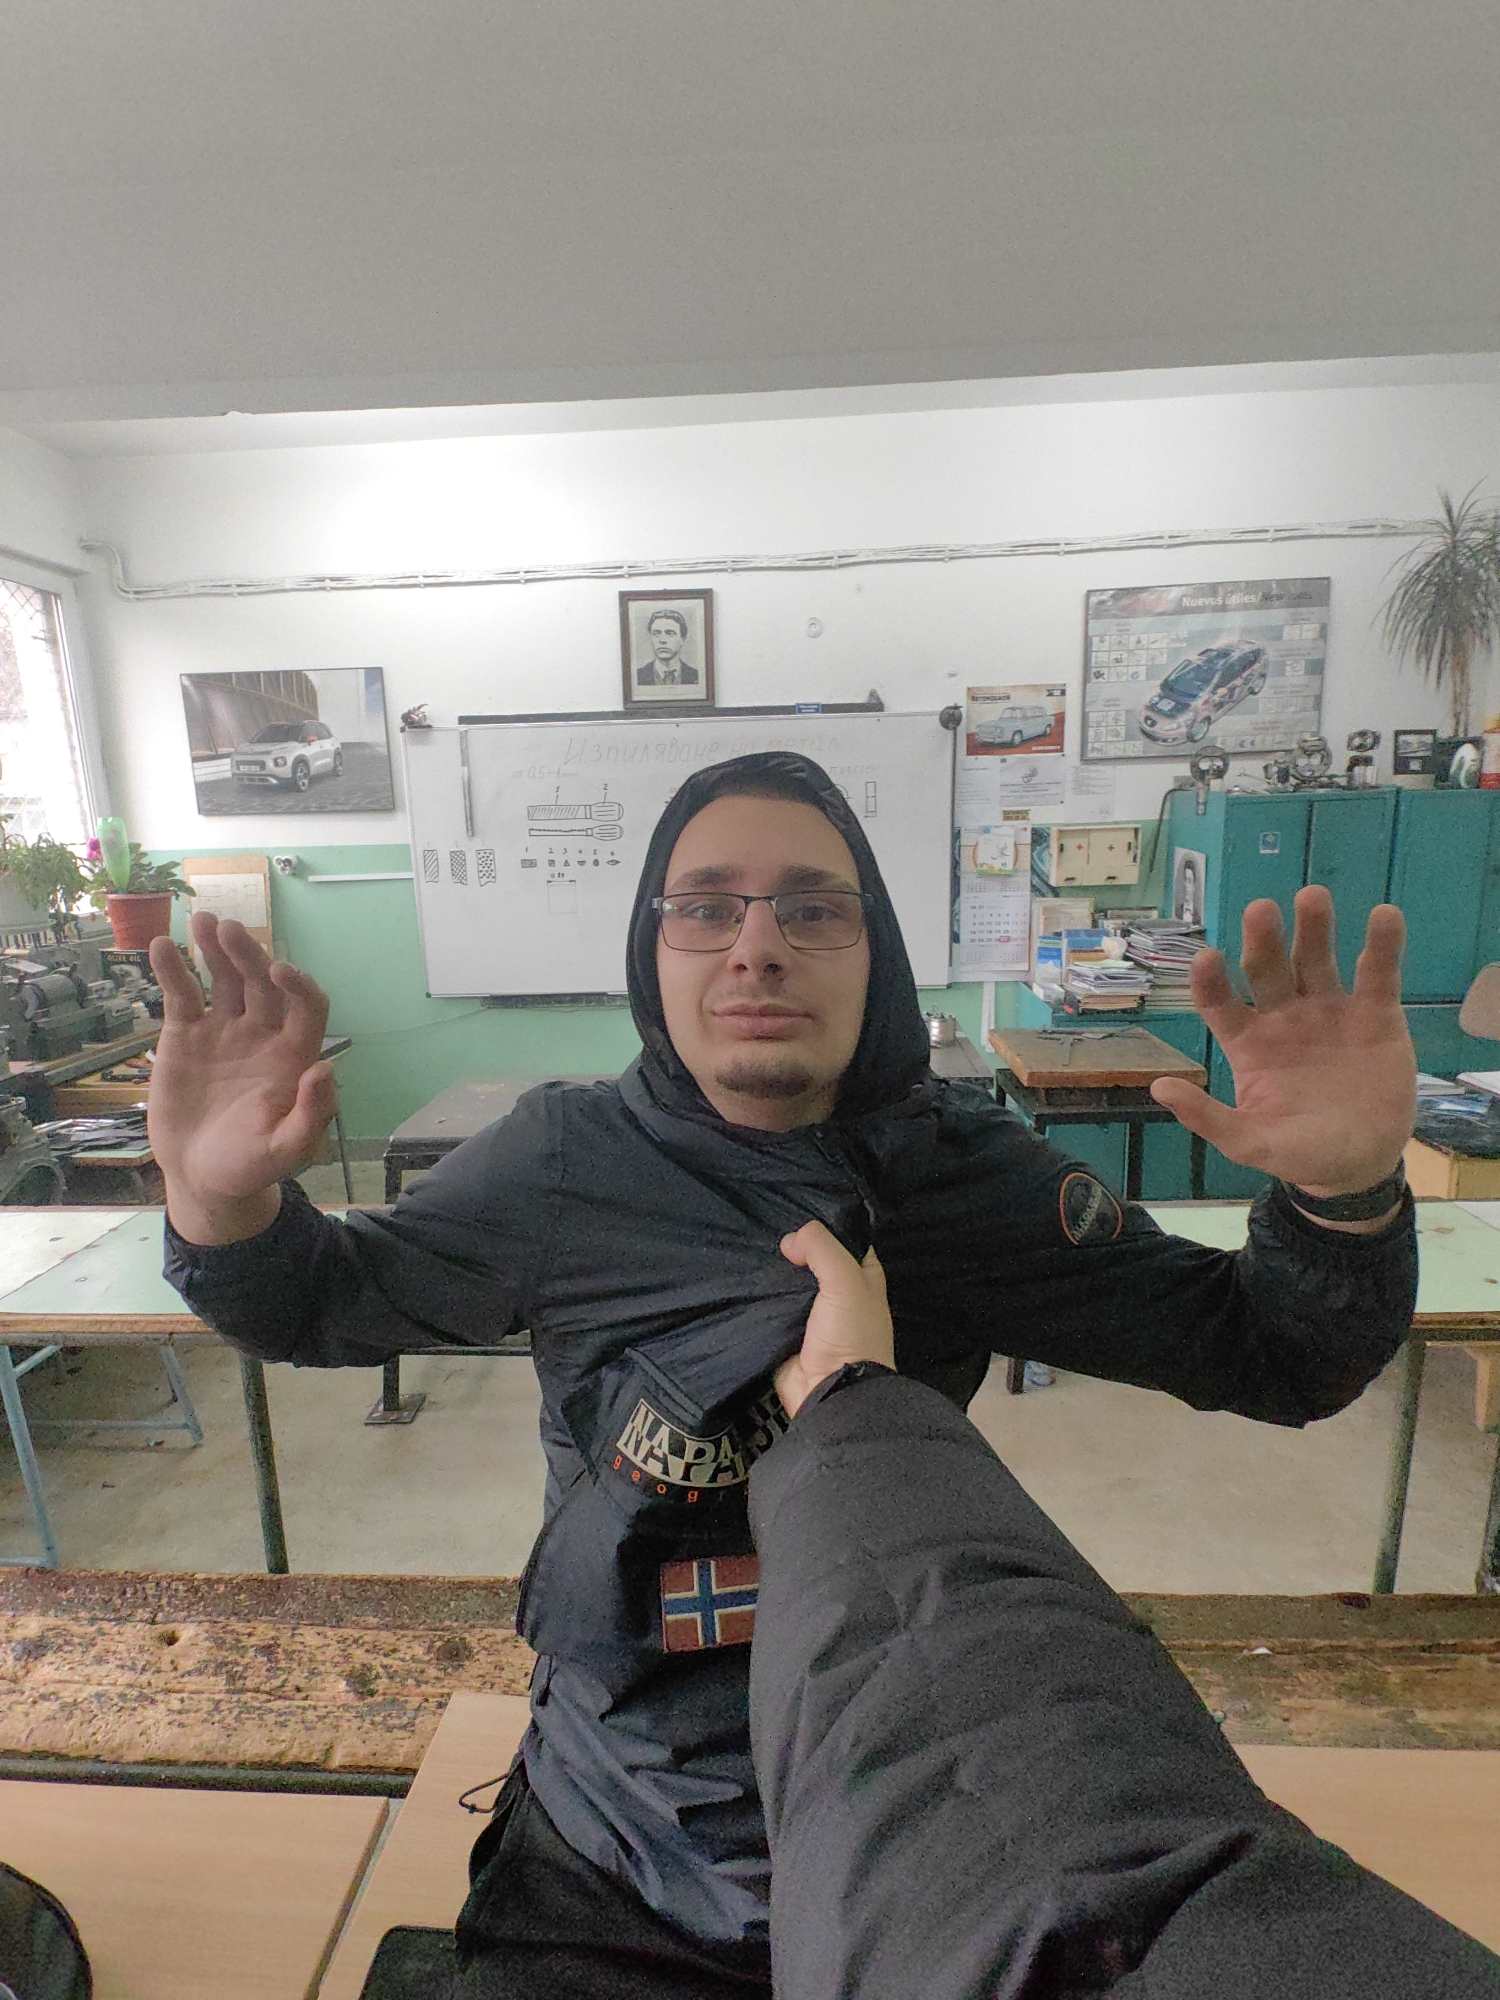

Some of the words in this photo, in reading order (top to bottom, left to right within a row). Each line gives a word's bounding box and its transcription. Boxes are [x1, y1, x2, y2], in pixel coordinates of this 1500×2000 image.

[1181, 594, 1223, 607] Nuevos
[563, 737, 719, 766] Изпиляване
[555, 785, 560, 793] 1
[602, 782, 609, 791] 2
[562, 847, 568, 855] 3
[593, 848, 598, 856] 5
